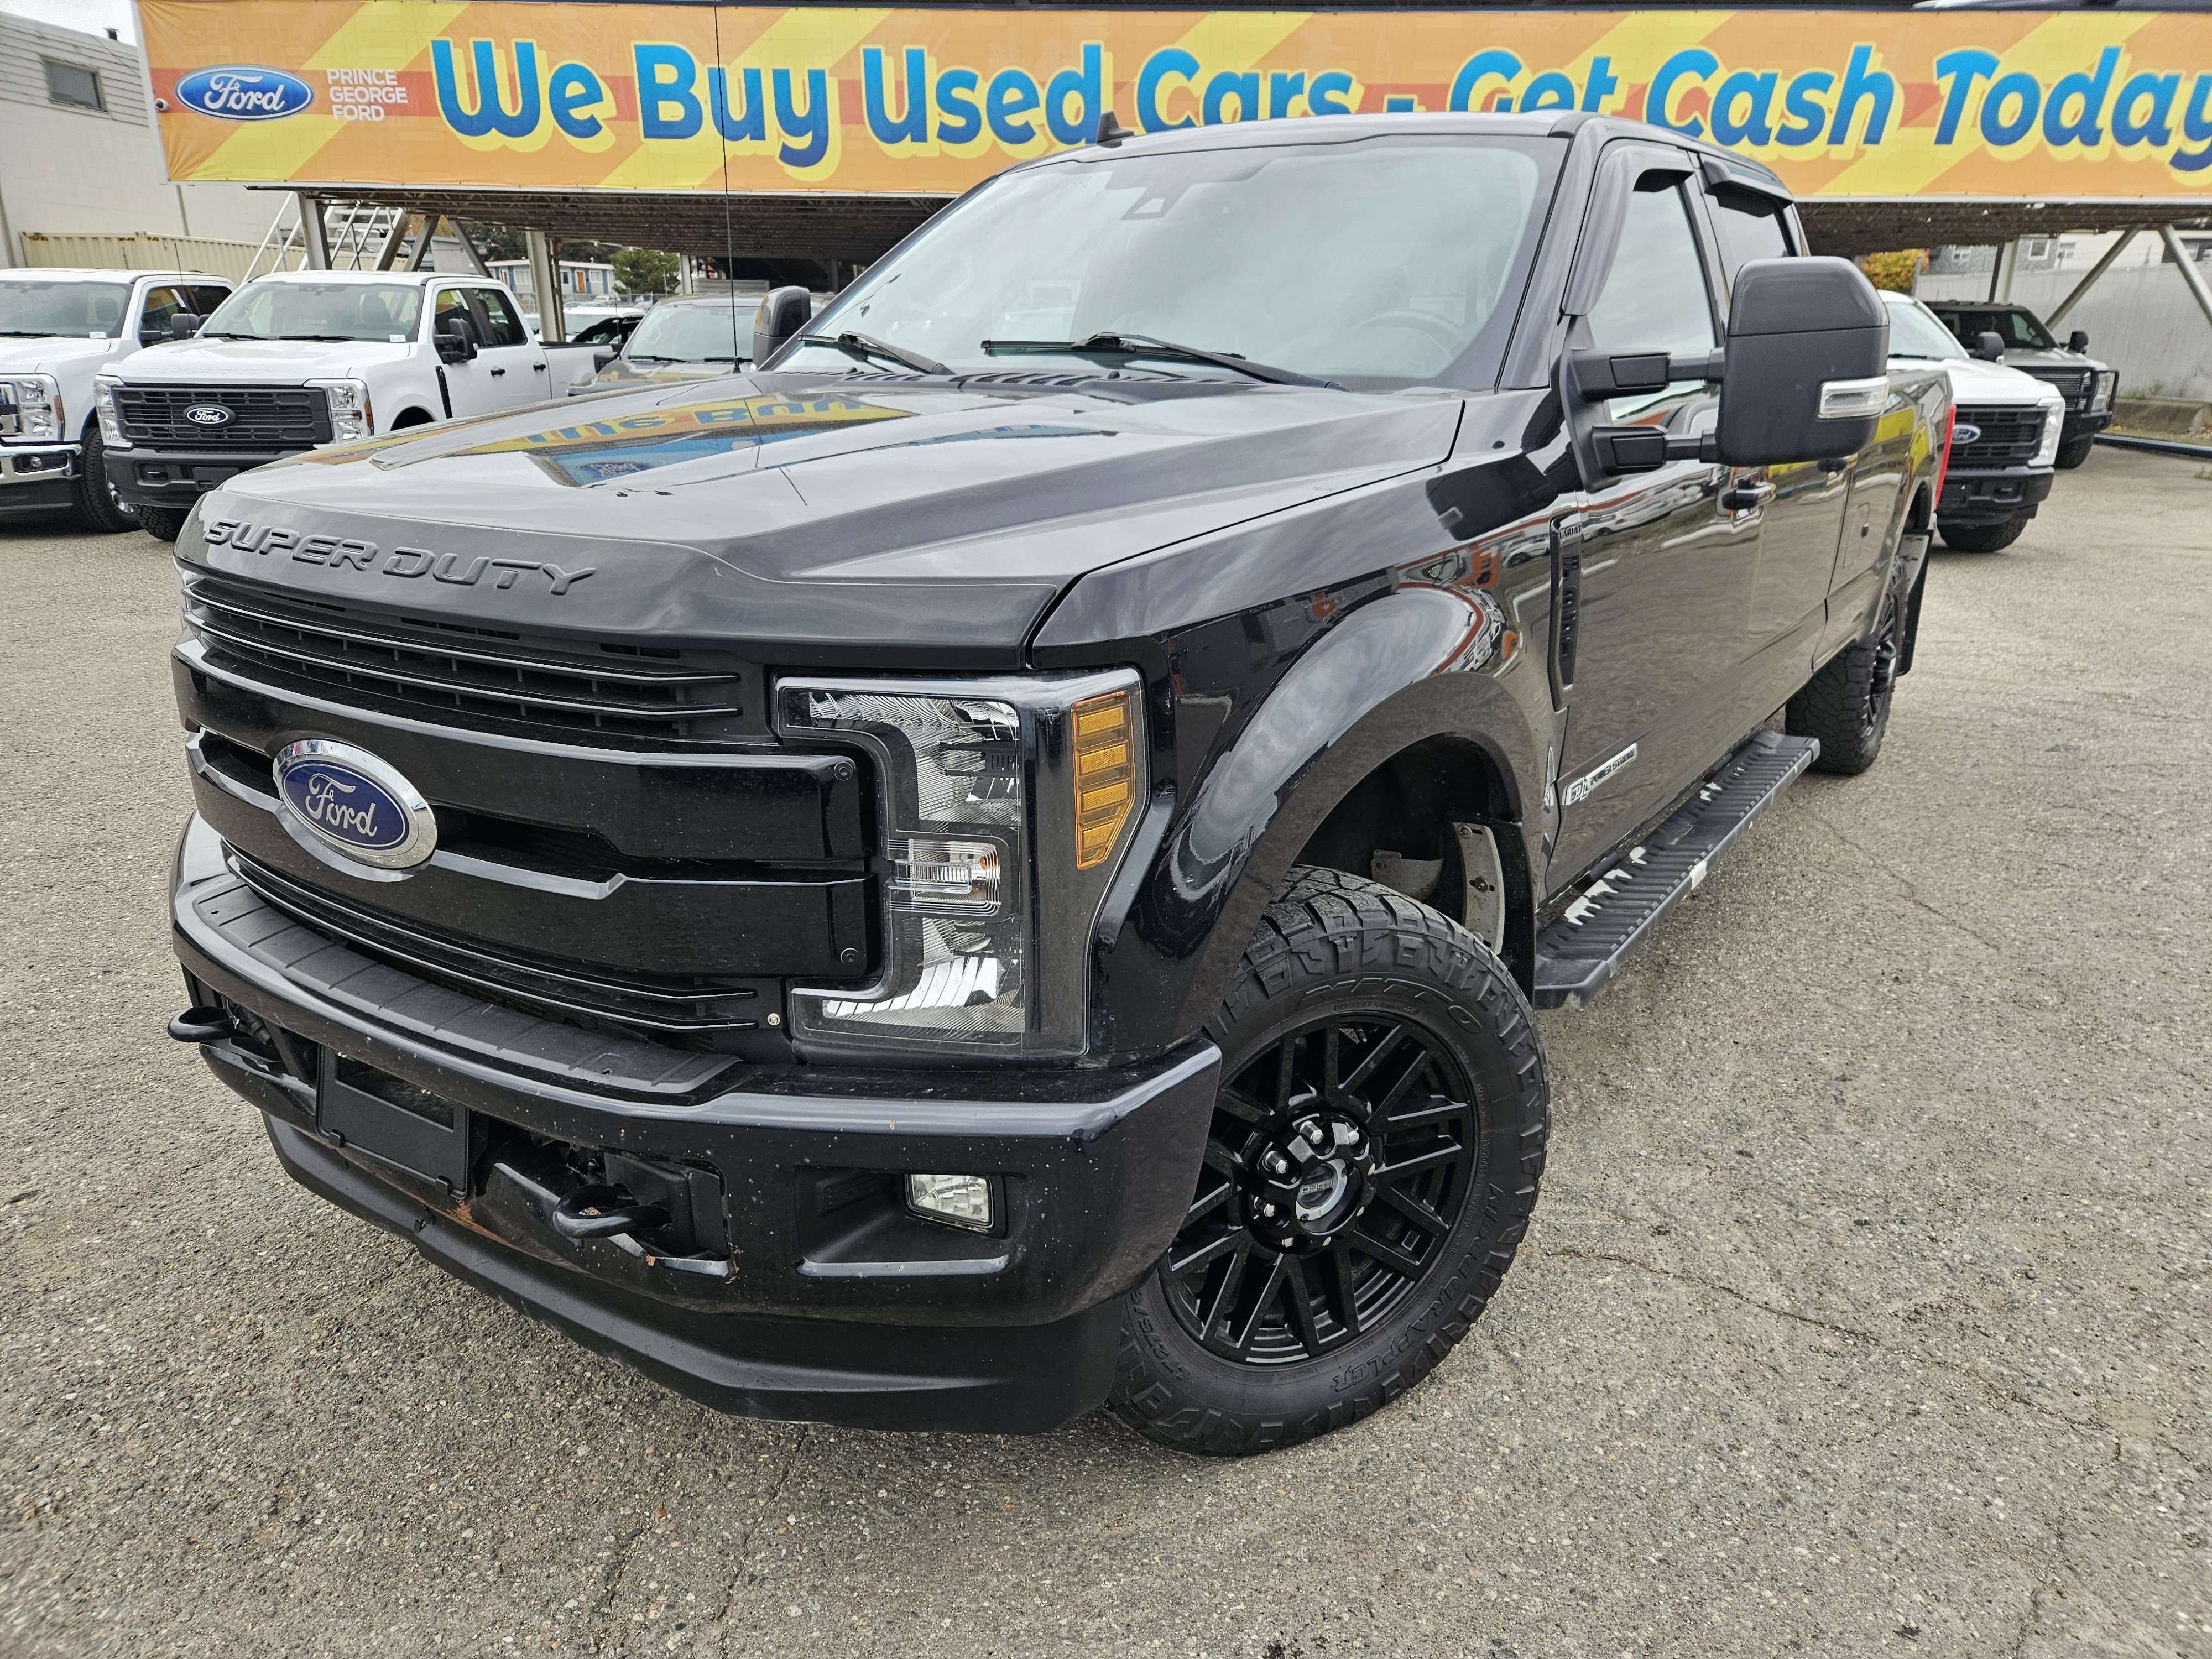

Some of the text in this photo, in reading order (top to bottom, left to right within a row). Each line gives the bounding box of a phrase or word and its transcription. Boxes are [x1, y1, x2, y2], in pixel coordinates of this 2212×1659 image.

[327, 68, 398, 86] PRINCE
[204, 73, 285, 111] Ford
[329, 86, 408, 105] GEORGE
[431, 40, 603, 138] We
[634, 44, 829, 167] Buy
[863, 44, 1101, 144] Used
[1137, 49, 1353, 133] Cars
[1647, 45, 1894, 145] Cash
[332, 105, 385, 122] FORD
[195, 410, 220, 421] Ford
[1559, 525, 1582, 539] LARIAT
[204, 519, 596, 596] SUPER DUTY
[305, 773, 377, 837] Ford
[1302, 1179, 1333, 1193] FORD
